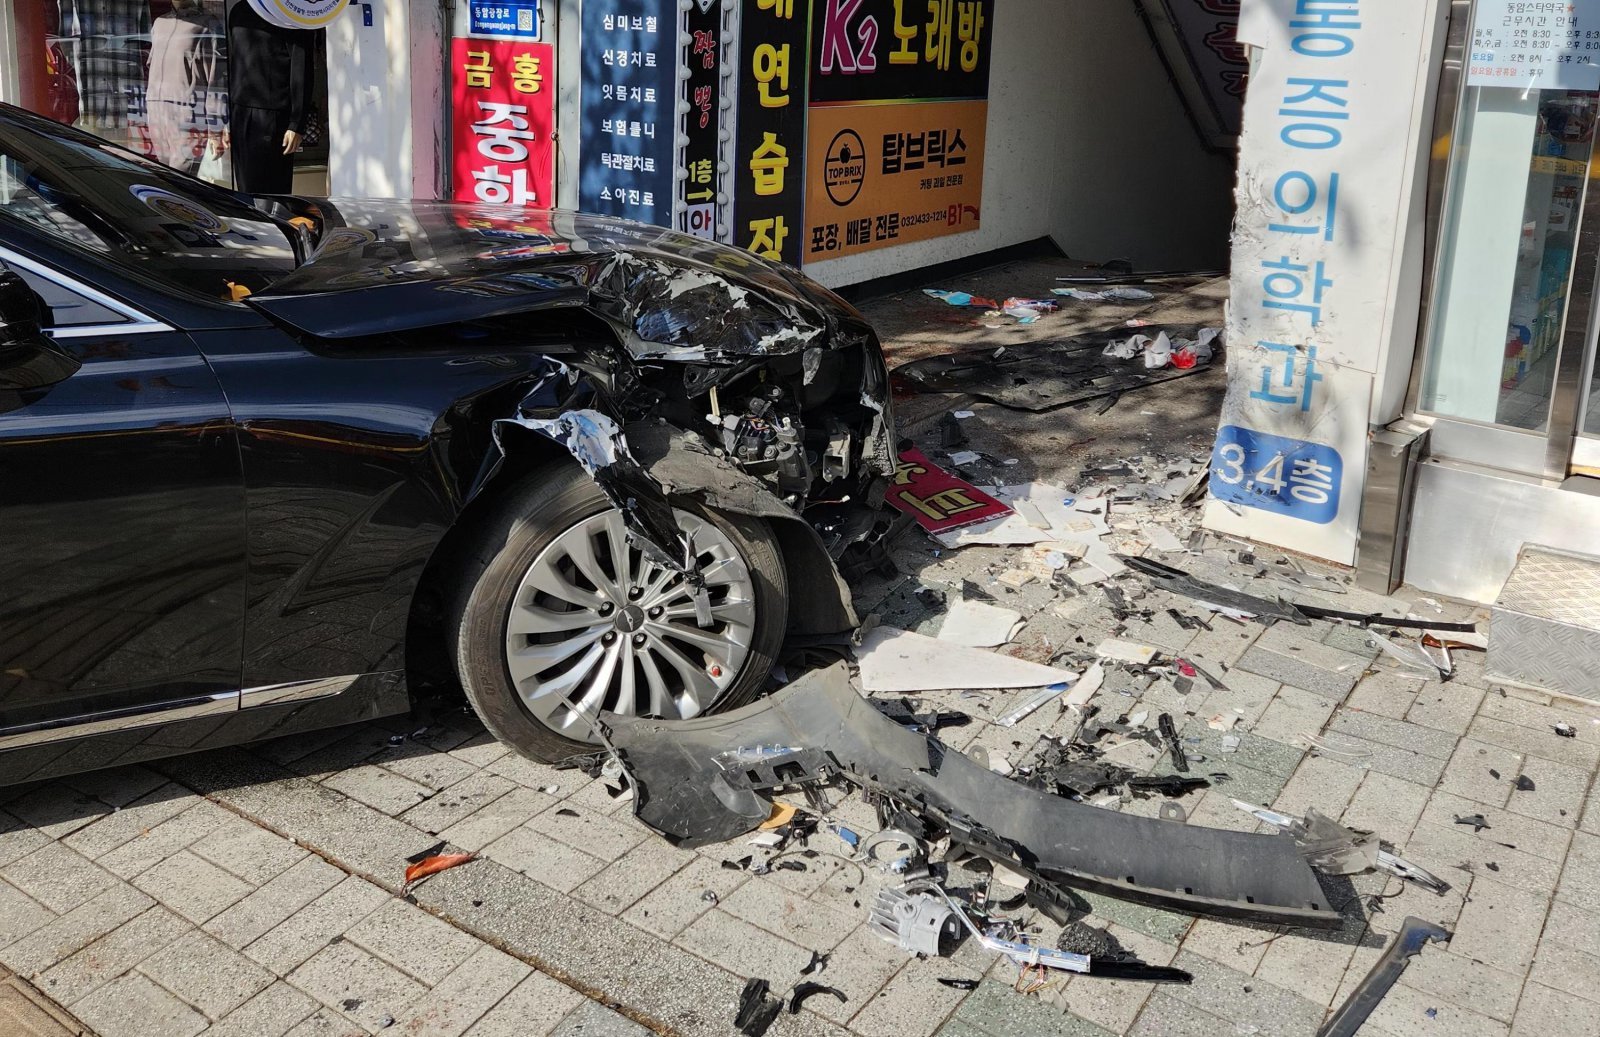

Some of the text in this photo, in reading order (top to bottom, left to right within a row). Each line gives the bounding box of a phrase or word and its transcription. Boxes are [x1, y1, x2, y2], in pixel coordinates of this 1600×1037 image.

[1507, 3, 1564, 14] 동암스타약국
[602, 14, 657, 33] 심미보철
[1503, 16, 1578, 28] 근무시간 안내
[820, 0, 984, 74] K2 노래방
[1513, 30, 1528, 38] 오전
[1532, 30, 1551, 38] 8:30
[1565, 30, 1581, 39] 오후
[1585, 30, 1600, 39] 8:3
[1512, 40, 1527, 48] 오전
[1532, 40, 1550, 49] 8:30
[1565, 41, 1581, 50] 오후
[1585, 41, 1600, 50] 8:0
[602, 49, 657, 67] 신경치료
[1510, 53, 1525, 62] 오전
[1529, 54, 1542, 63] 8시
[1557, 55, 1573, 64] 오후
[1577, 55, 1591, 64] 2시
[602, 84, 657, 103] 잇몸치료
[601, 119, 655, 139] 보험틀니
[882, 129, 967, 175] 탑브릭스
[601, 152, 656, 173] 턱관절치료
[688, 159, 713, 184] 1층
[828, 165, 862, 179] TOP BRIX
[599, 186, 655, 206] 소아진료
[811, 203, 962, 252] 포장, 배달 전문 032)433-1214 B1
